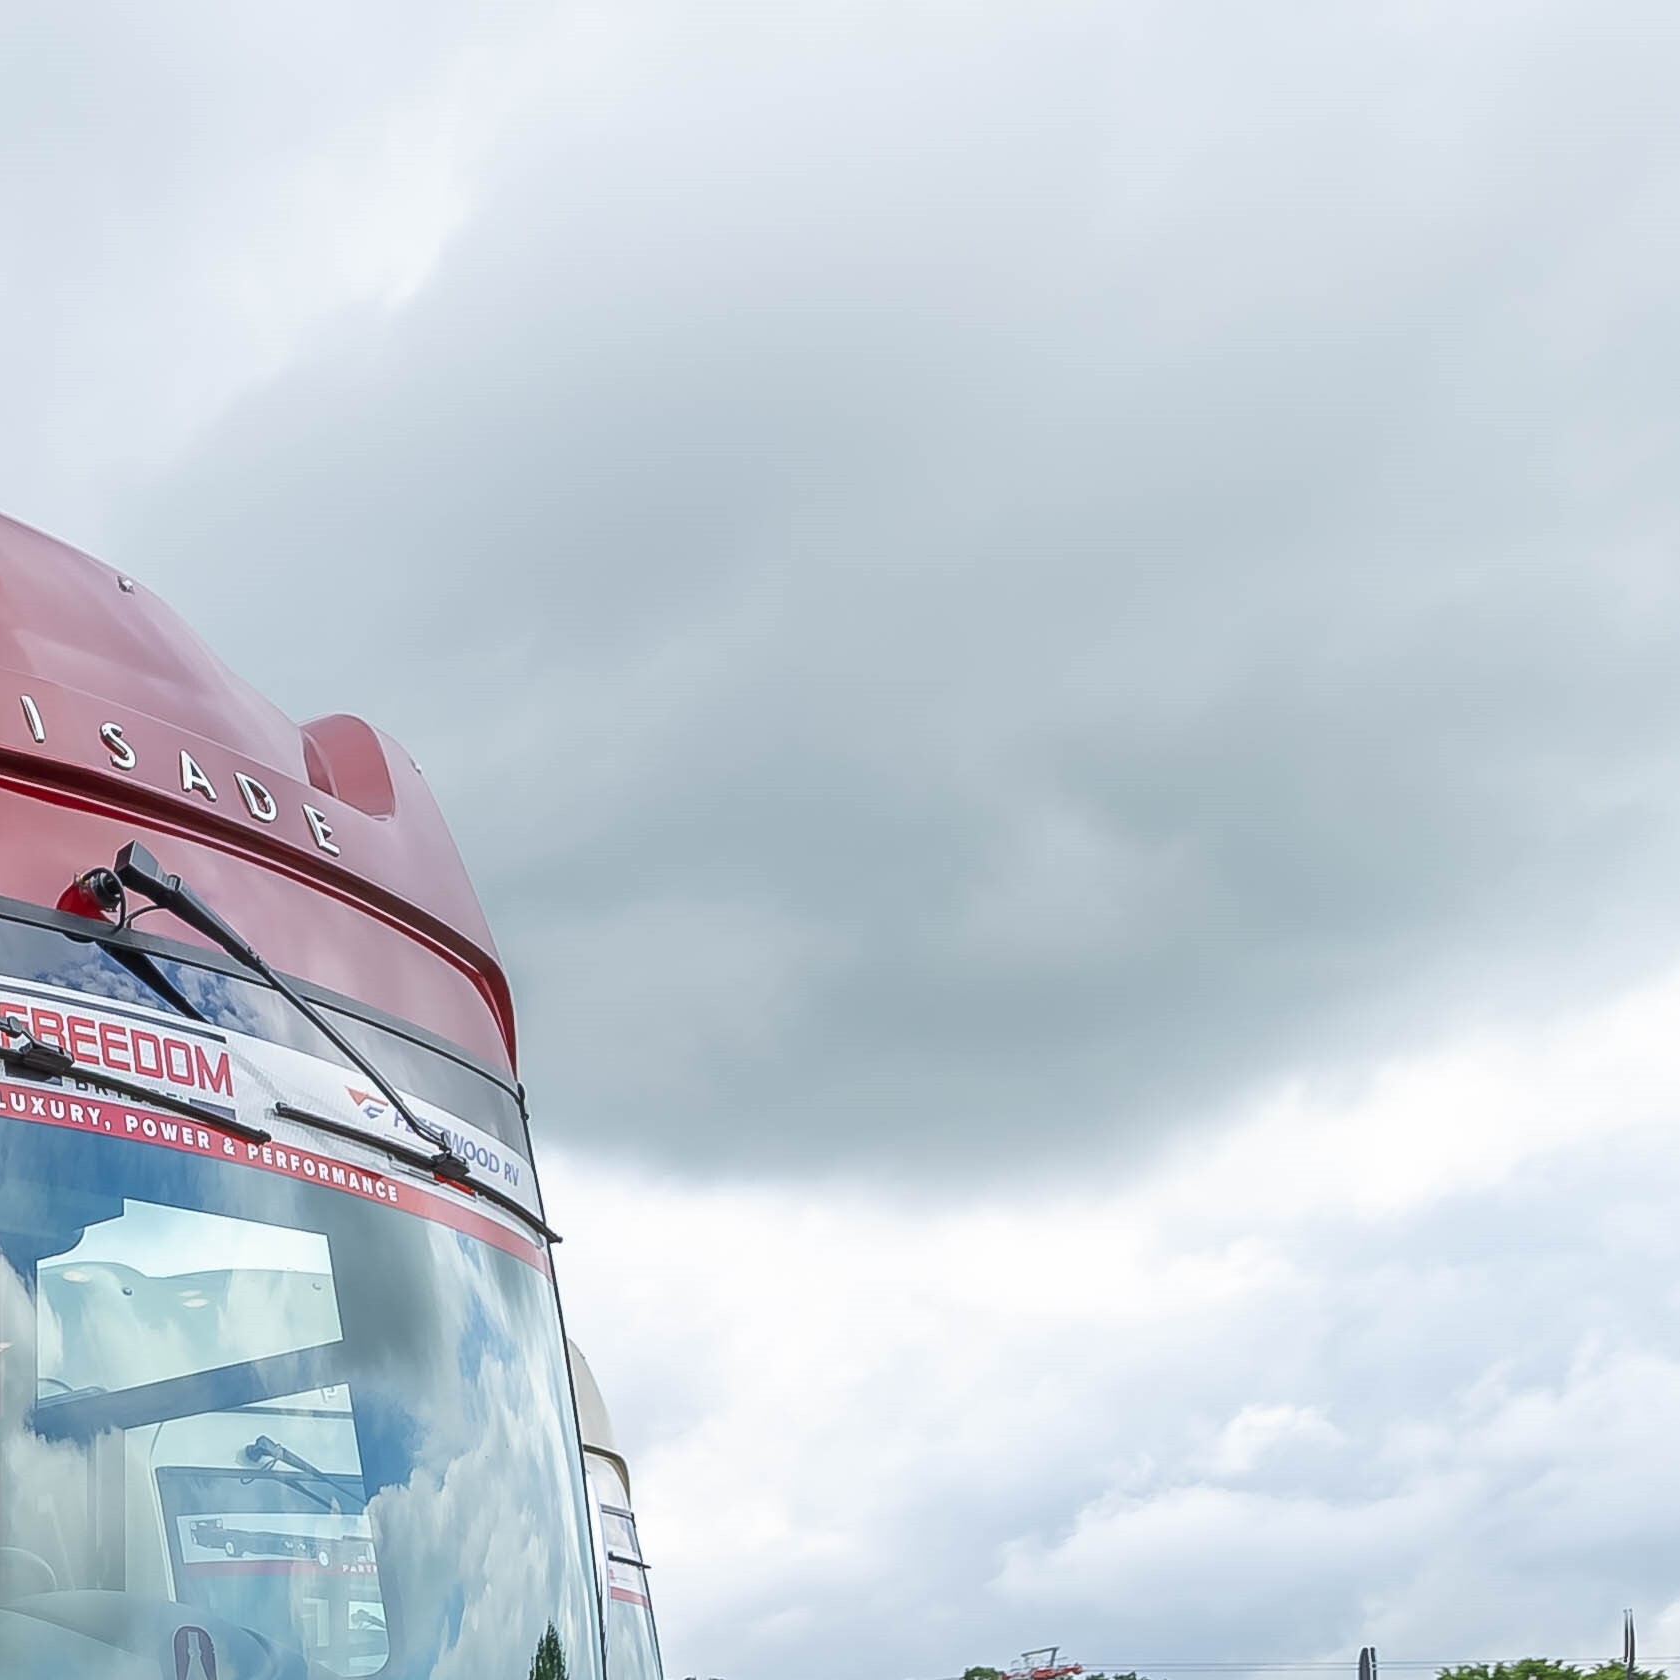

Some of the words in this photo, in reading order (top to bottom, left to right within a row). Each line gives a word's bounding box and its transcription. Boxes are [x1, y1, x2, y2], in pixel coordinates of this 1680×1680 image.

[124, 1114, 211, 1149] POWER
[223, 1137, 236, 1156] &
[246, 1142, 400, 1203] PERFORMANCE
[504, 1160, 521, 1187] RV
